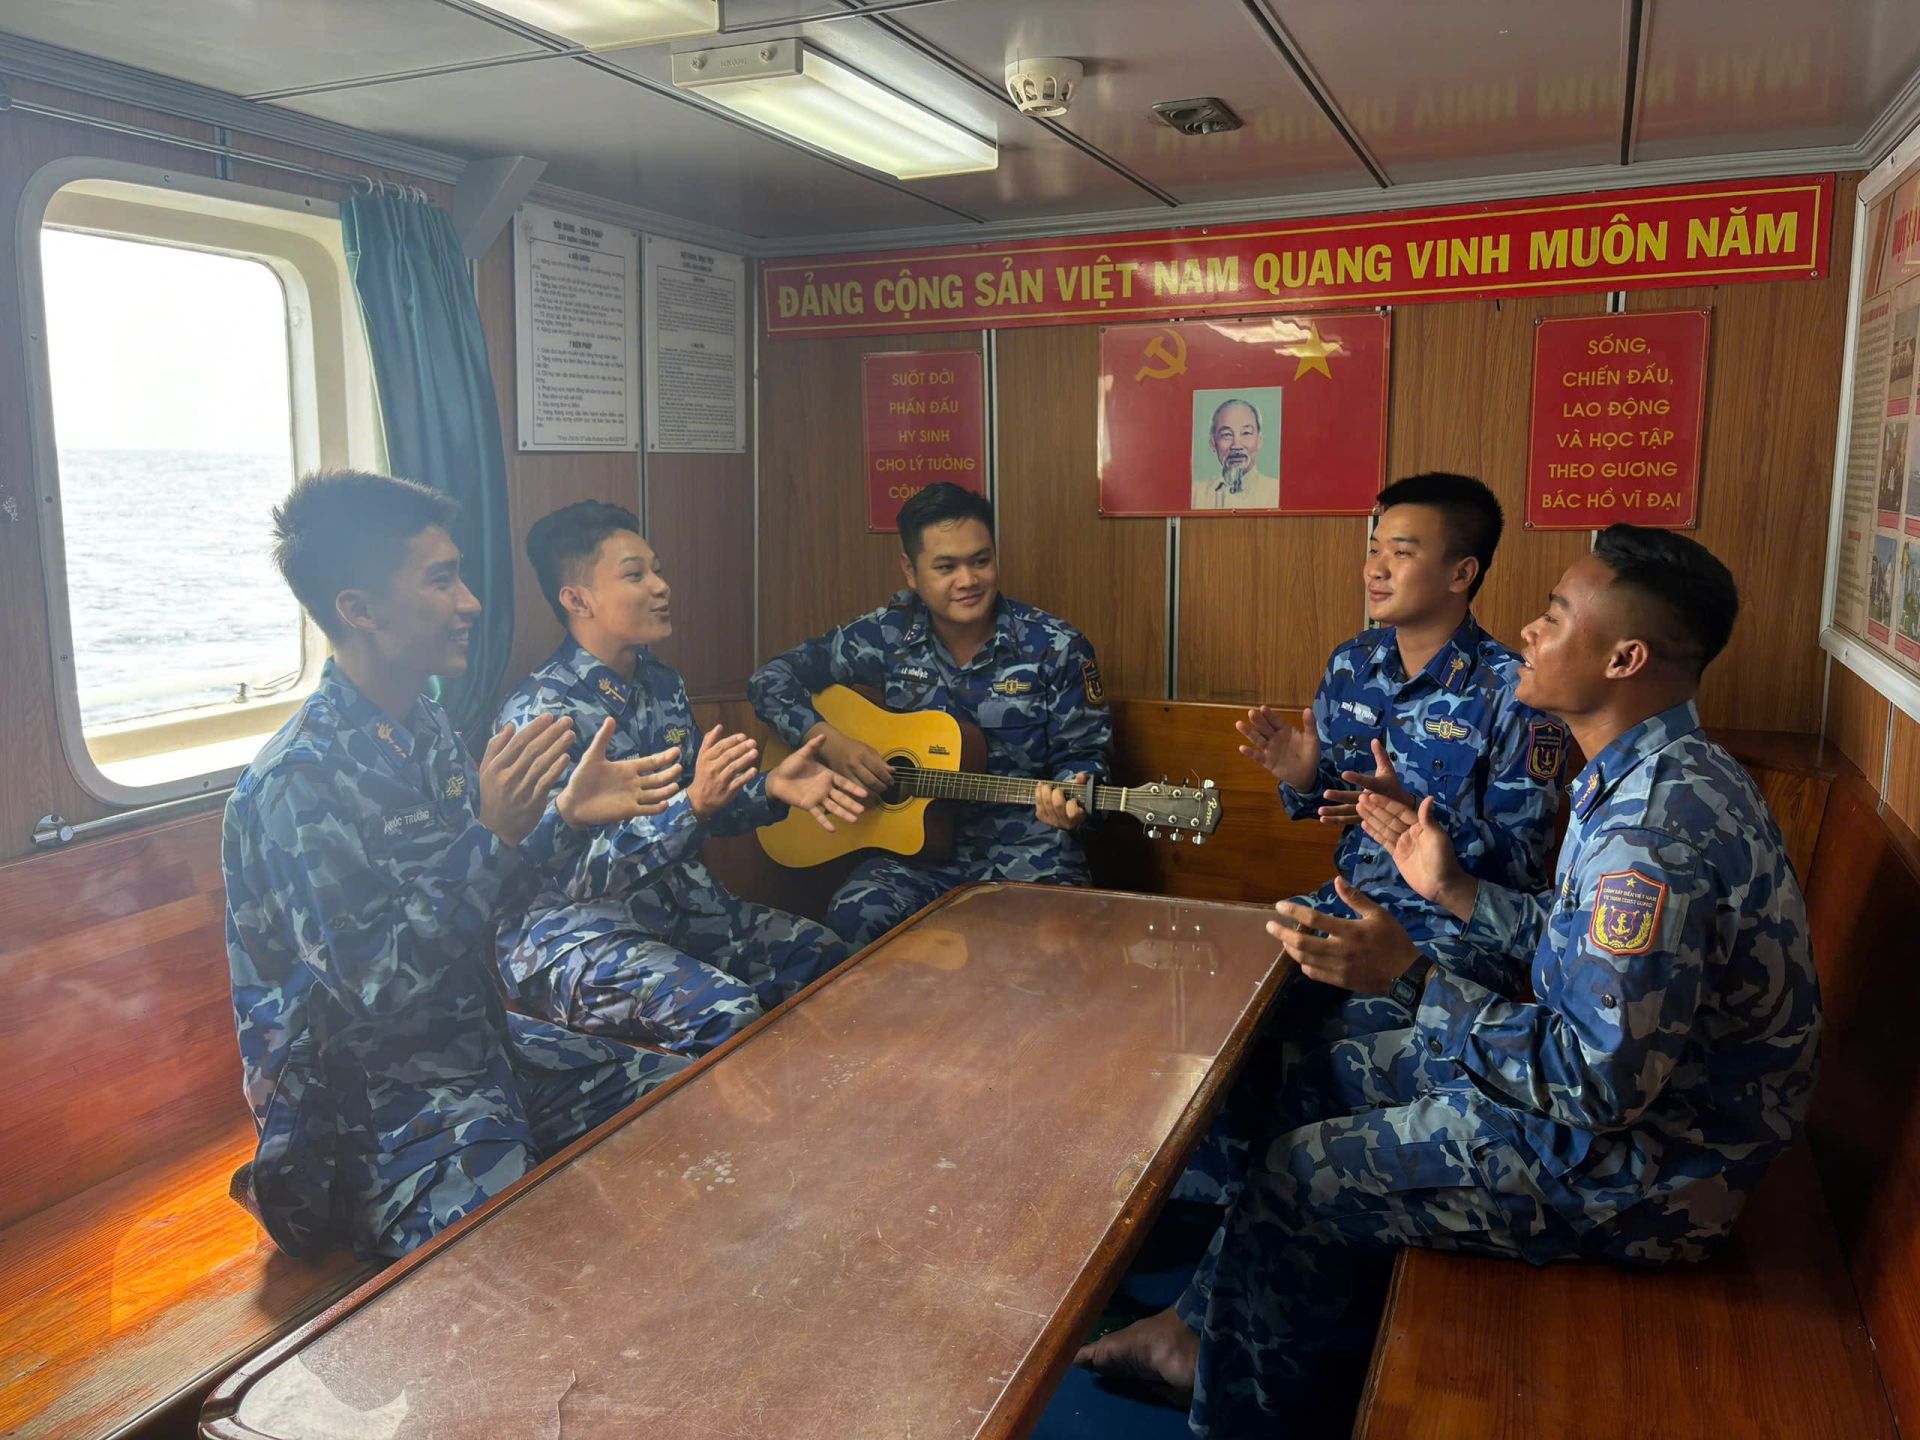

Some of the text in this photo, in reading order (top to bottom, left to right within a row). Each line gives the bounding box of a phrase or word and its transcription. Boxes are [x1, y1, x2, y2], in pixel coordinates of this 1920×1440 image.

[779, 271, 863, 318] ĐẢNG
[874, 268, 963, 318] CỘNG
[975, 257, 1044, 306] SẢN
[1056, 255, 1141, 308] VIỆT
[1153, 255, 1240, 296] NAM
[1253, 243, 1392, 295] QUANG
[1406, 234, 1510, 279] VINH
[1529, 213, 1668, 271] MUÔN
[1687, 206, 1798, 259] NĂM
[1588, 333, 1651, 355] SỐNG,
[1562, 362, 1673, 387] CHIẾN ĐẤU,
[1563, 397, 1670, 419] LAO ĐỘNG
[899, 430, 950, 443] HY SINH
[1556, 428, 1674, 450] VÀ HỌC TẬP
[875, 458, 906, 471] CHO
[910, 455, 923, 471] LÝ
[1548, 461, 1677, 479] THEO GƯƠNG
[888, 483, 924, 502] CỘN
[1542, 487, 1681, 511] BÁC HỒ VĨ ĐẠI
